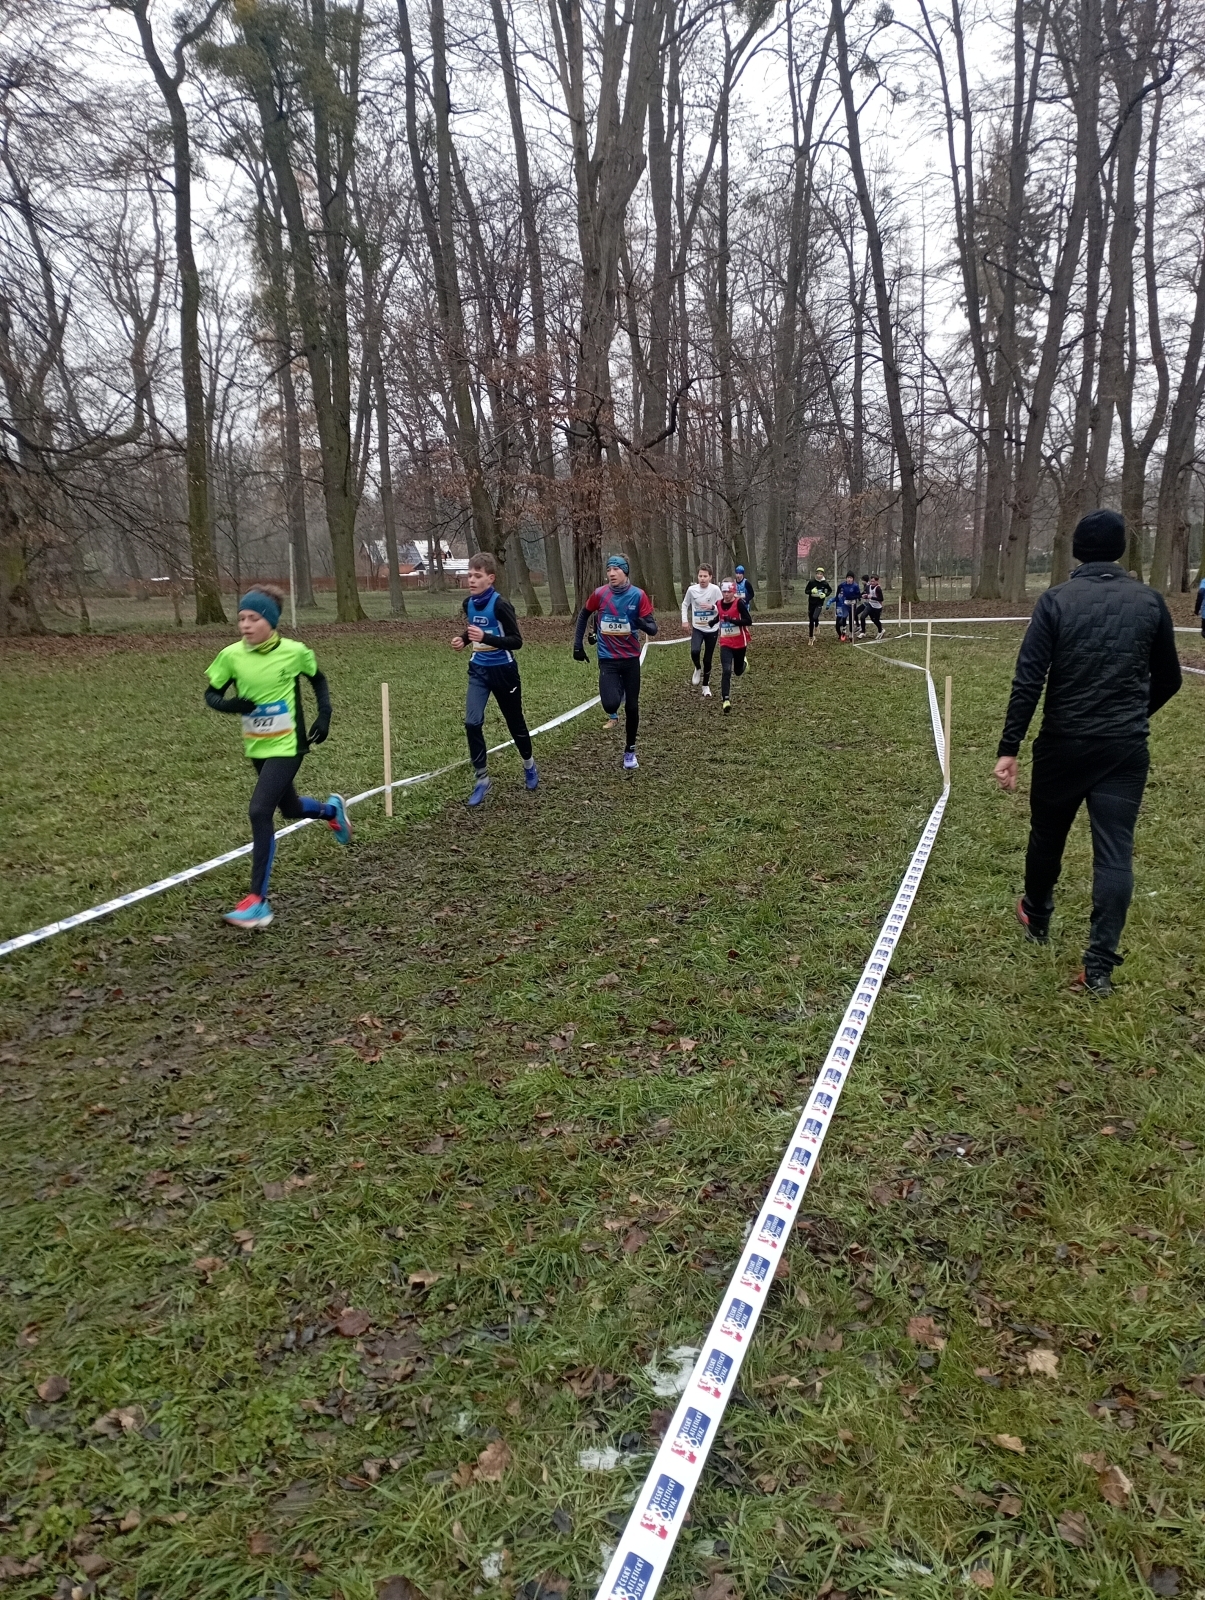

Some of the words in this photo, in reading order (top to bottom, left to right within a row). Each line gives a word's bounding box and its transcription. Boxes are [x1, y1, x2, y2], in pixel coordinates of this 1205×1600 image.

[253, 716, 274, 728] 627
[681, 1417, 692, 1433] ČESKÝ
[689, 1410, 702, 1438] ATLETICKÝ
[696, 1427, 704, 1441] SVAZ
[652, 1486, 664, 1504] ČESKÝ
[661, 1479, 676, 1509] ATLETICKÝ
[668, 1497, 678, 1513] SVAZ
[618, 1566, 631, 1587] ČESKÝ
[627, 1557, 645, 1593] ATLETICKÝ
[634, 1579, 646, 1597] SVAZ
